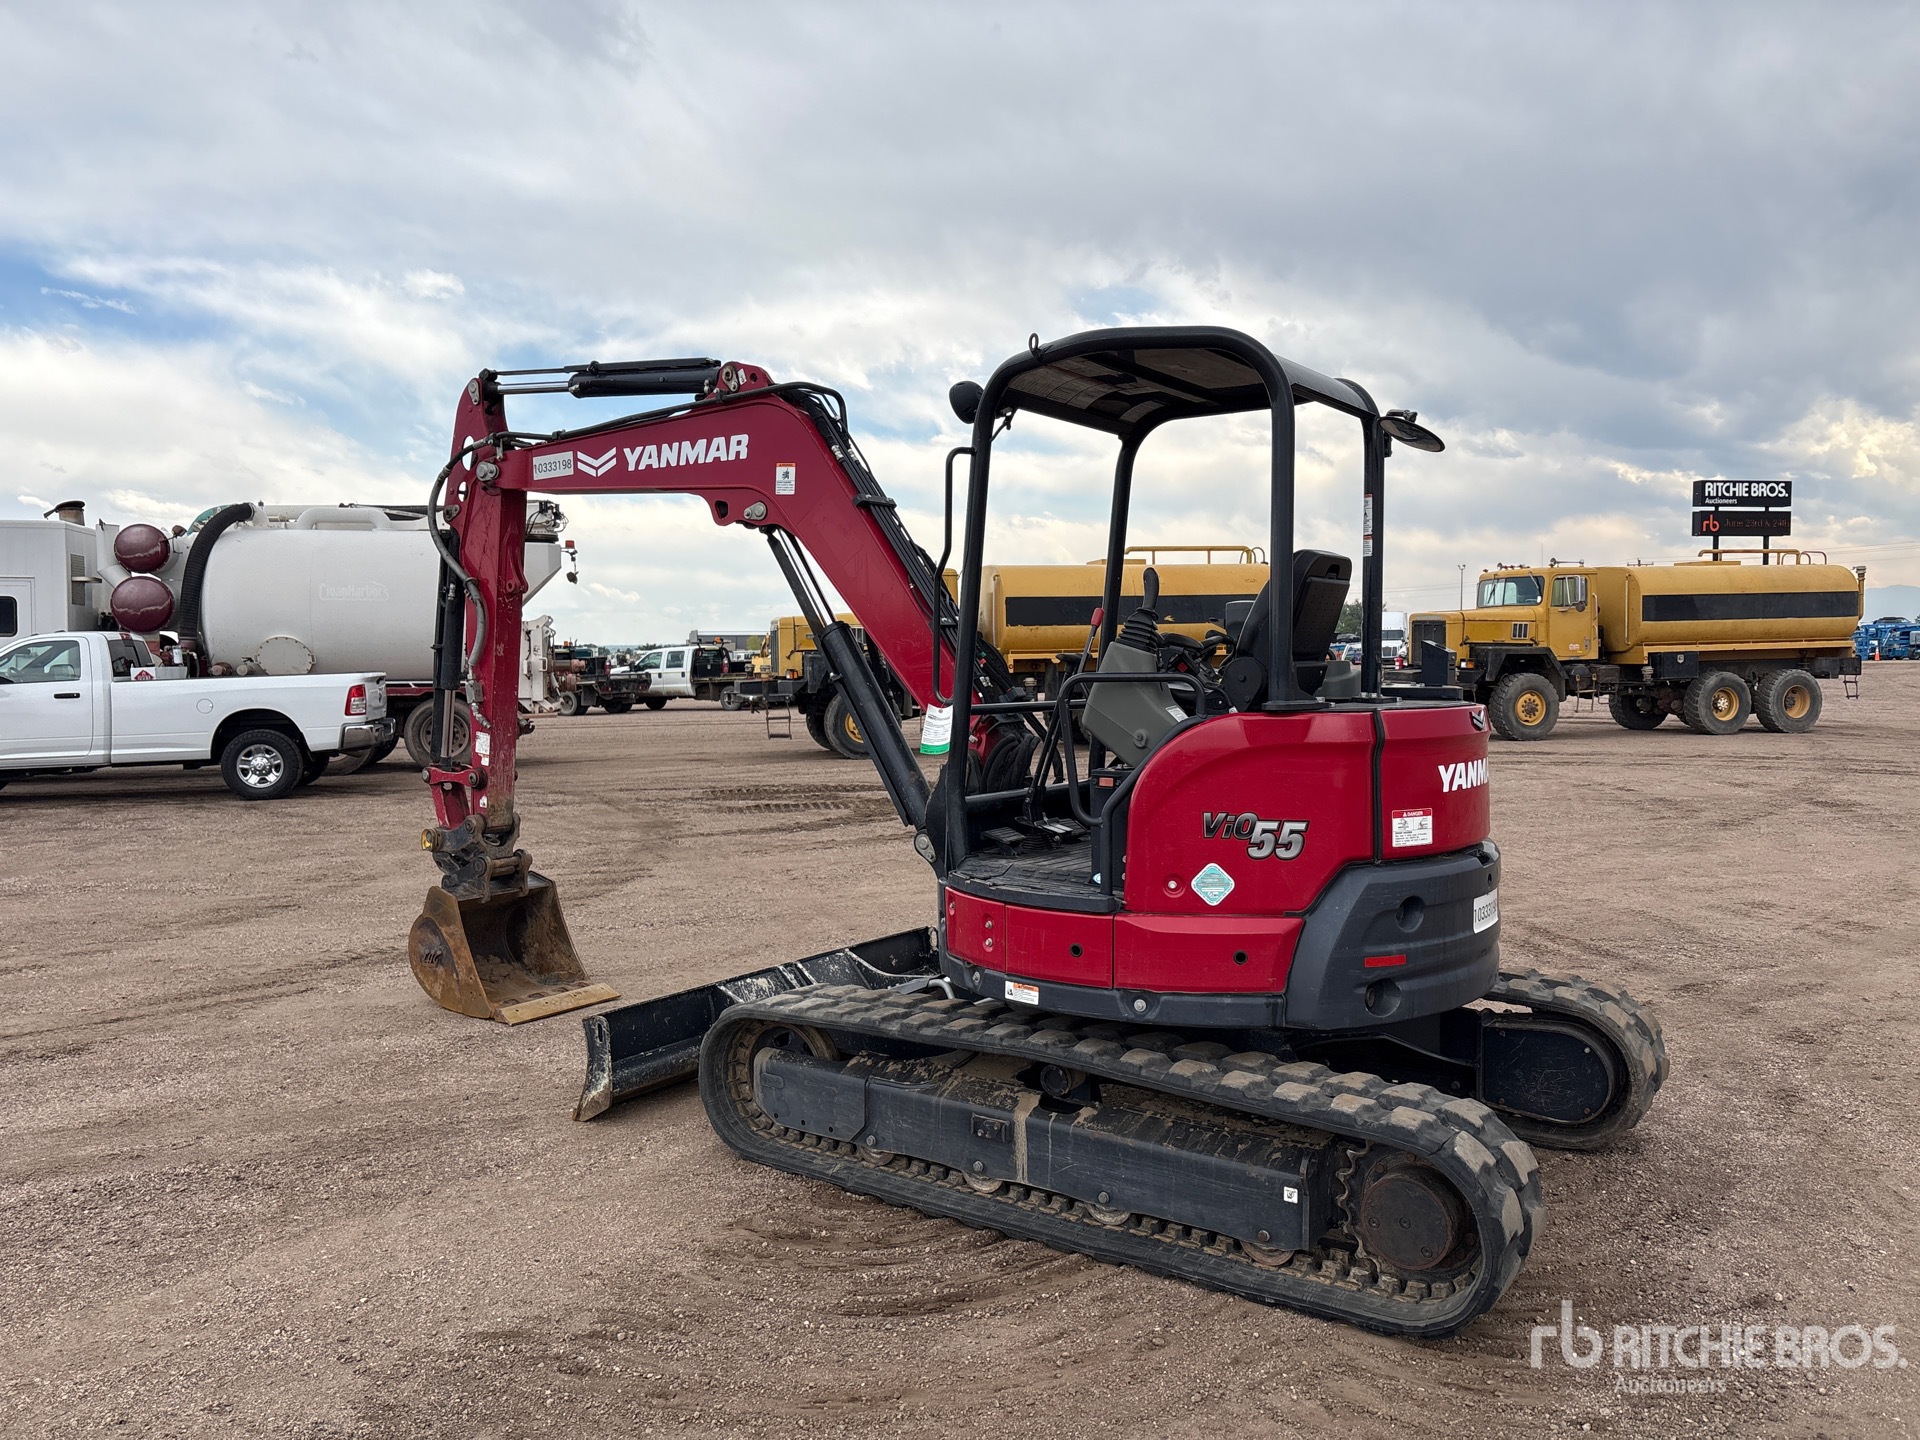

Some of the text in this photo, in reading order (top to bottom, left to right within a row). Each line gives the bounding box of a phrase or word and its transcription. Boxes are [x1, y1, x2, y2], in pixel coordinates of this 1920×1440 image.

[623, 434, 749, 471] YANMAR
[534, 459, 572, 474] 10333198
[1705, 482, 1789, 498] RITCHIE BROS.
[1705, 497, 1738, 505] Auctioneers
[1702, 514, 1720, 532] rb
[1438, 756, 1489, 793] YANM
